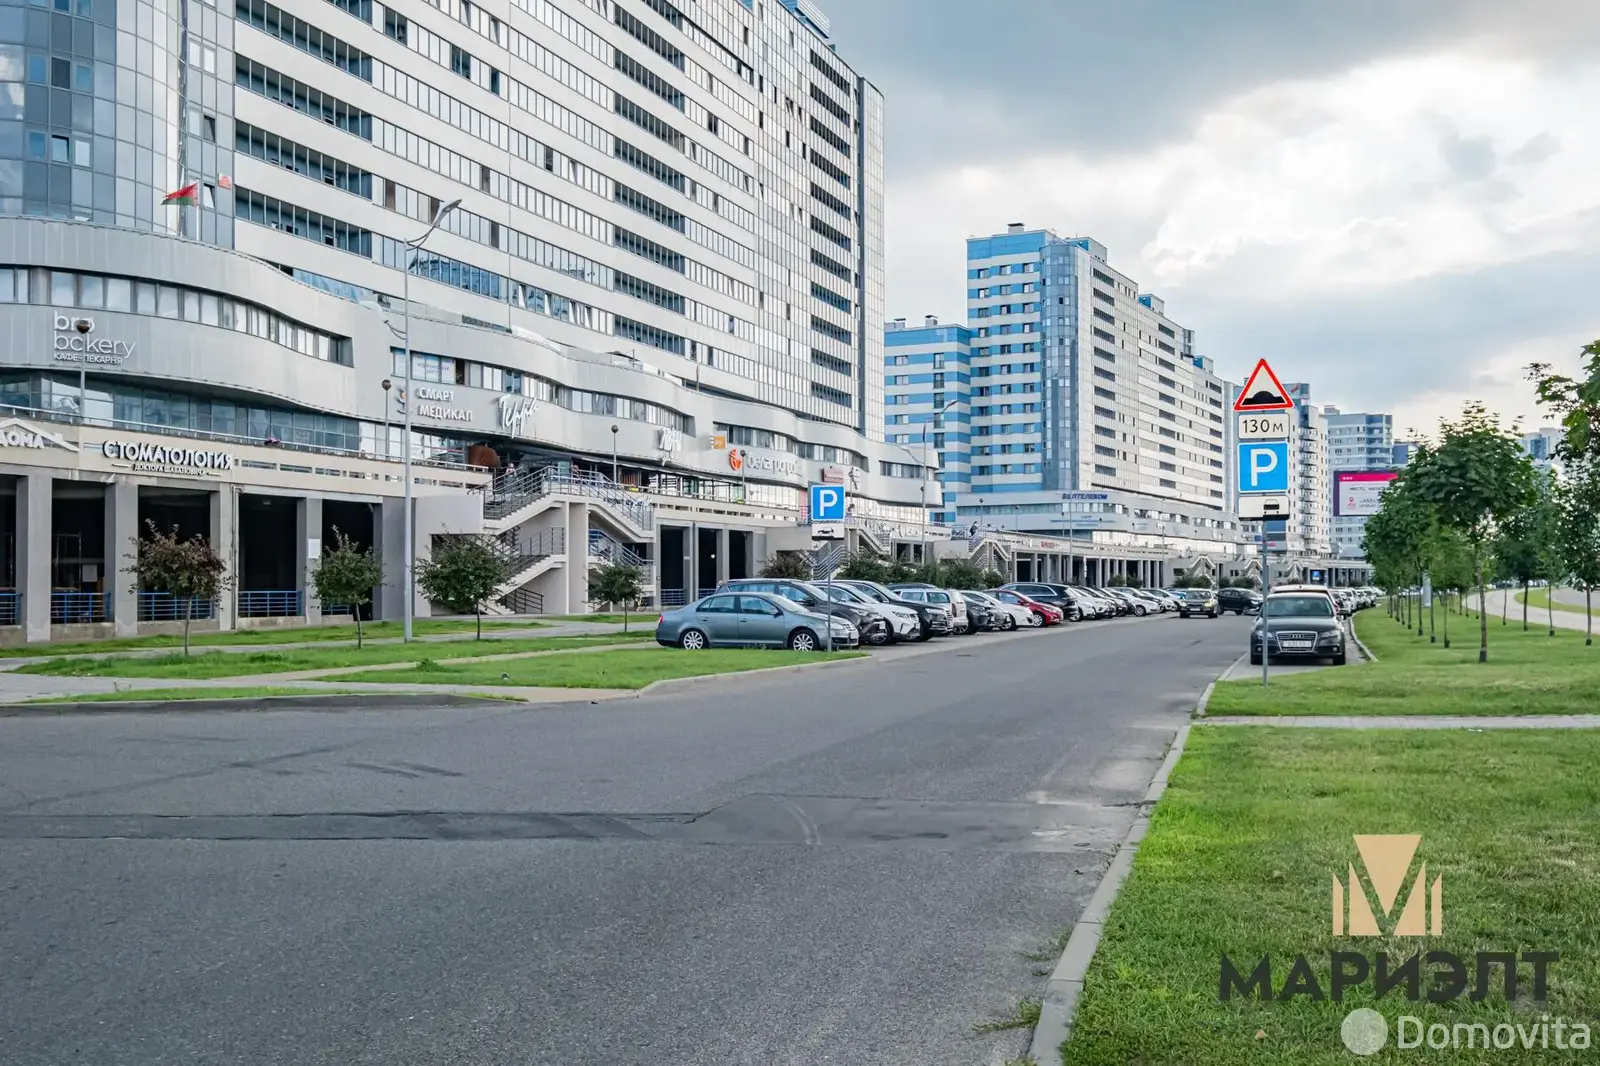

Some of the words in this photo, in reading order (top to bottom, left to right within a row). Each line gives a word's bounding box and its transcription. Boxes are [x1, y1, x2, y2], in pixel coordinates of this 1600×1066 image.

[417, 386, 454, 402] СМАРТ
[418, 404, 473, 422] МЕДИКАЛ
[1242, 419, 1270, 433] 130
[102, 440, 233, 471] СТОМАТОЛОГИЯ
[1250, 448, 1278, 487] P
[819, 489, 838, 517] P
